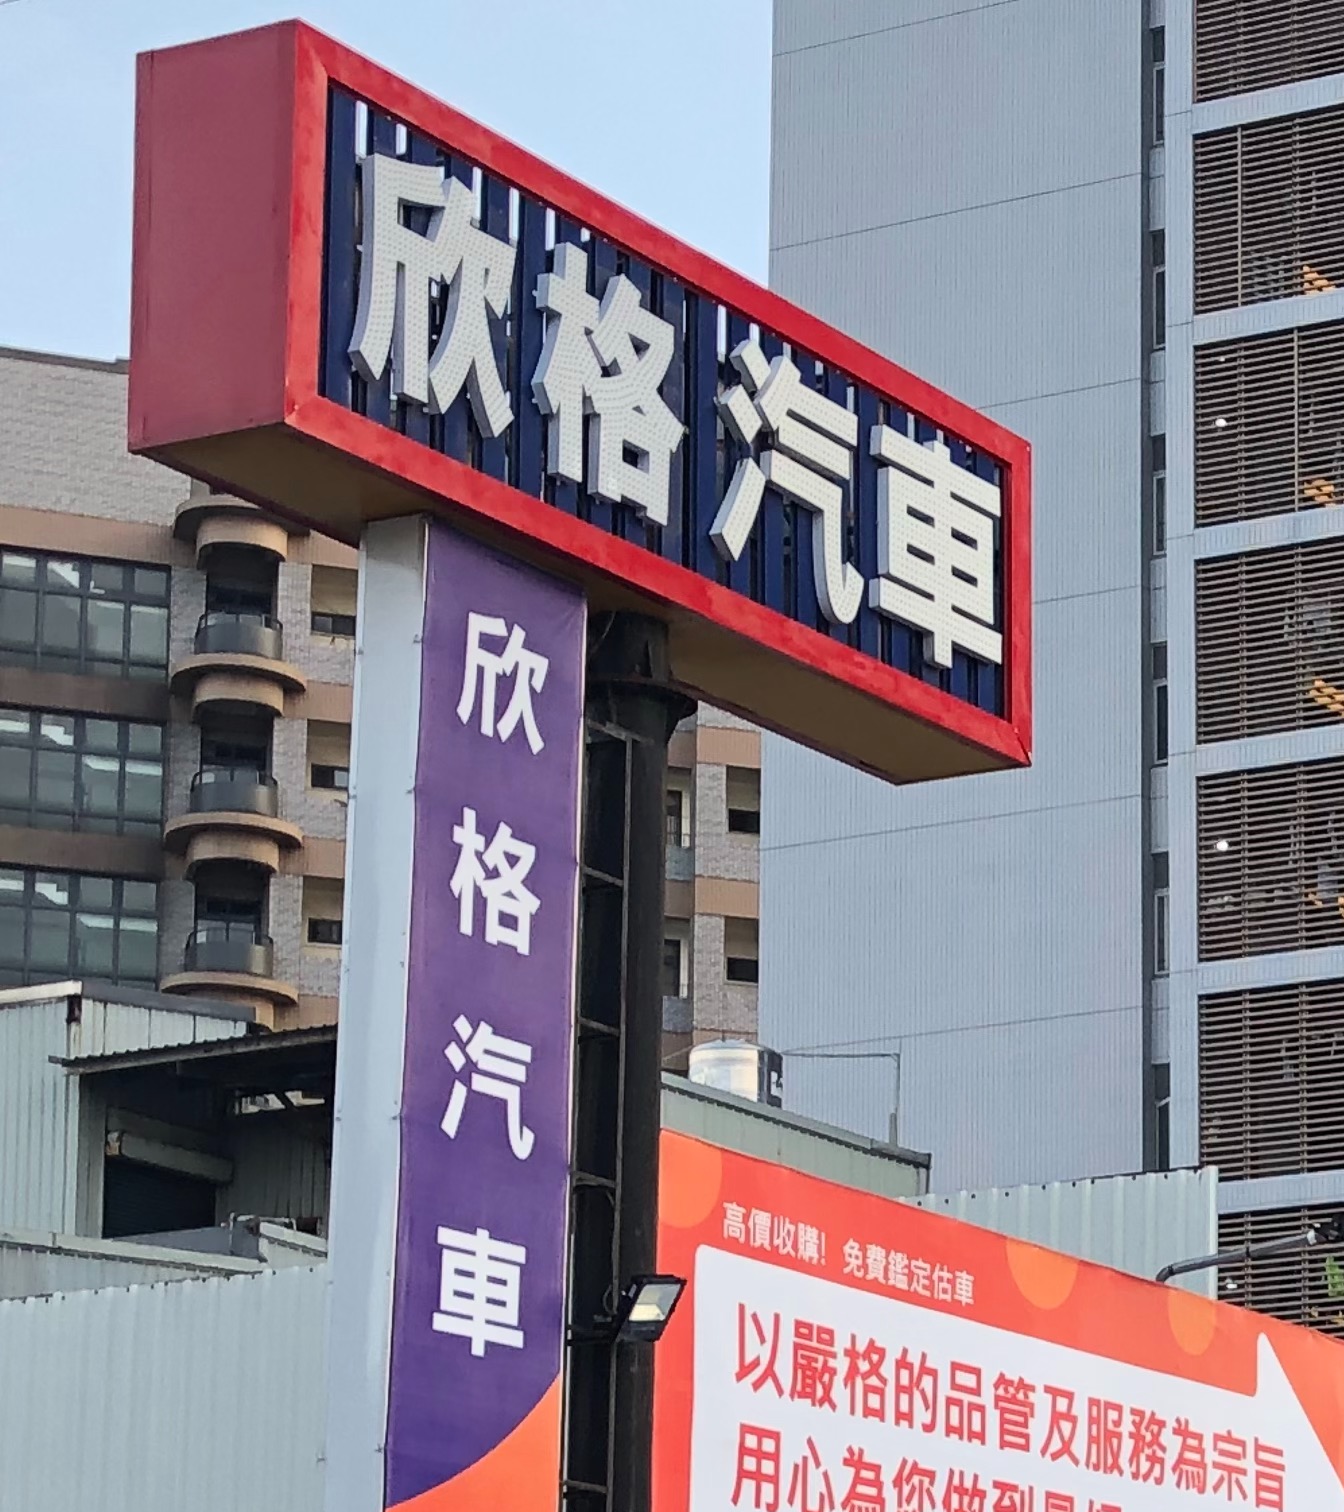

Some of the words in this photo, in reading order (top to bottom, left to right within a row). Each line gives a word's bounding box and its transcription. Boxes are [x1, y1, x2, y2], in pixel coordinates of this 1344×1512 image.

[348, 152, 1002, 669] 欣格汽車
[432, 611, 549, 1358] 欣格汽車
[842, 1239, 976, 1307] 免費鑑定估車
